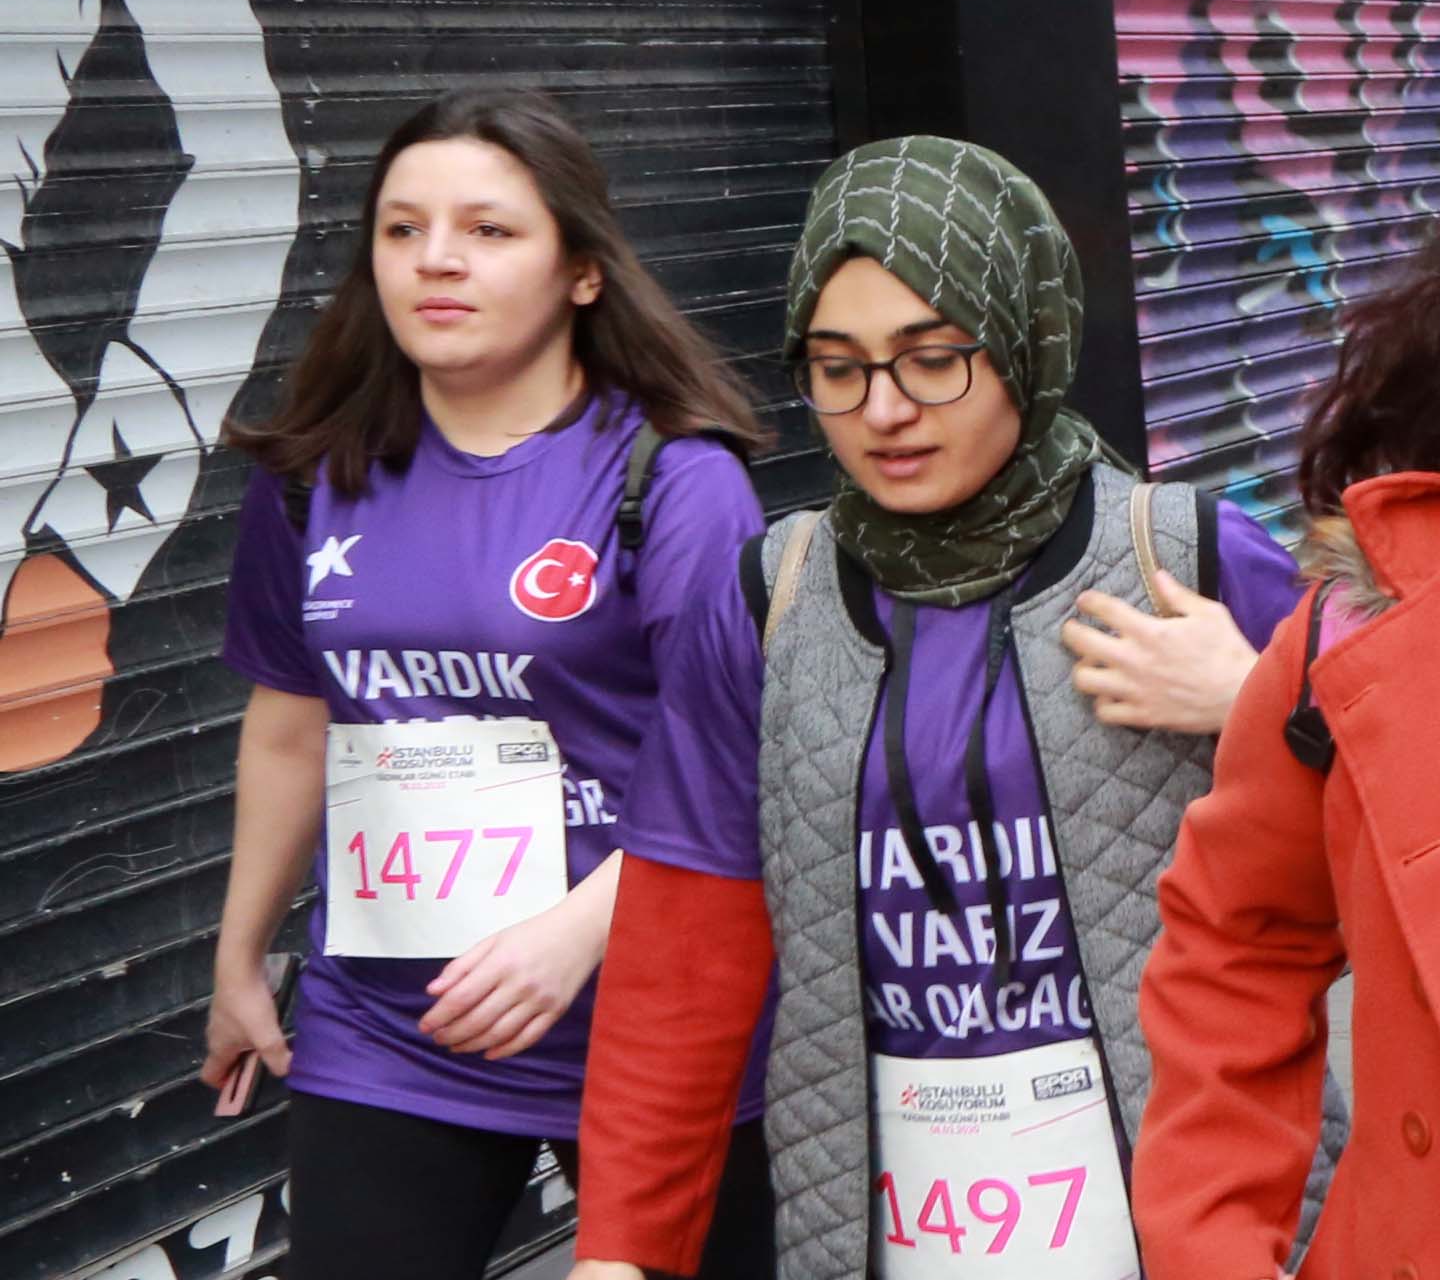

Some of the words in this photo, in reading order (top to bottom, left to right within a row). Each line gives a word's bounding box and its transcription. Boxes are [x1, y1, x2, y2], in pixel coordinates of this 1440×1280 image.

[322, 648, 536, 703] VARDIK
[346, 825, 536, 902] 1477
[918, 1082, 1005, 1098] İSTANBULU
[873, 1165, 1088, 1255] 1497
